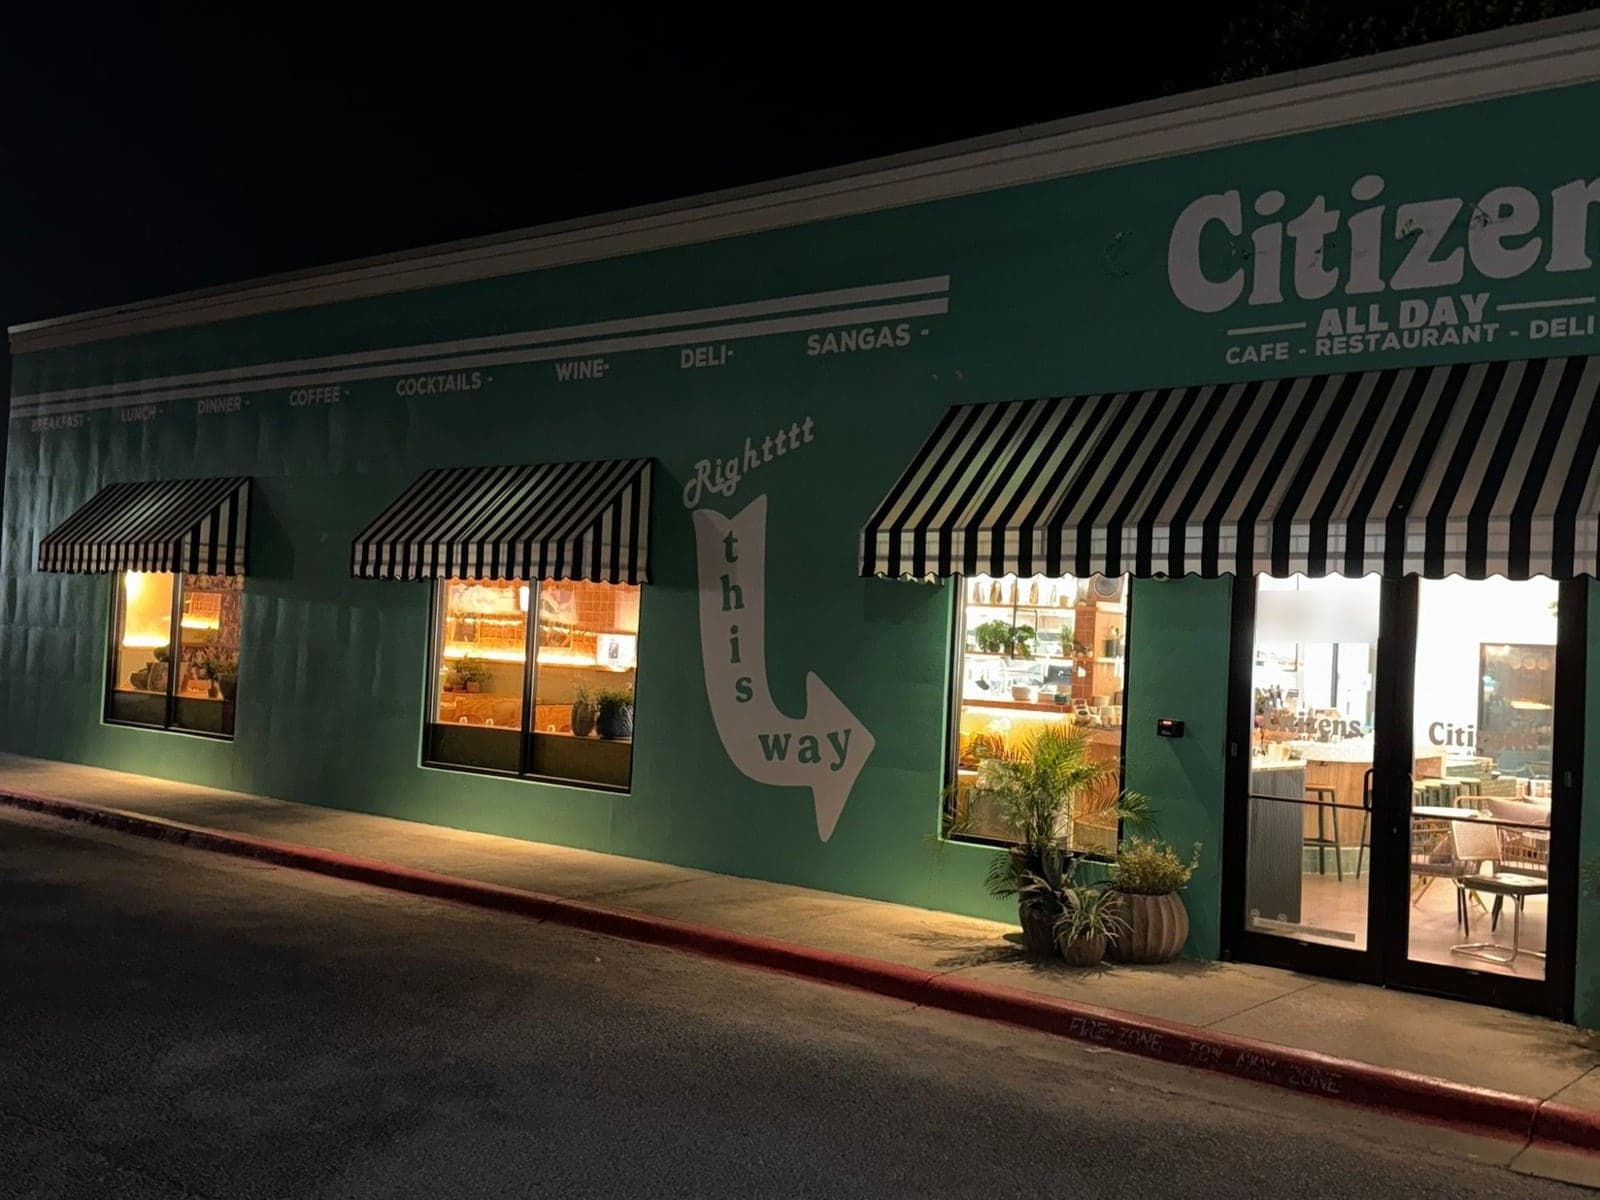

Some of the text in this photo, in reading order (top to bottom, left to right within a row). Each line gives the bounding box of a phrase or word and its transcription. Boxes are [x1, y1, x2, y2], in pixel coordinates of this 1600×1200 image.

[1225, 341, 1289, 366] CAFE
[1314, 322, 1499, 358] RESTAURANT
[1529, 315, 1595, 340] DELI
[1316, 292, 1491, 338] ALL DAY
[31, 413, 84, 432] BREAKFAST
[120, 406, 156, 423] LUNCH
[196, 395, 242, 416] DINNER
[288, 386, 341, 407] COFFEE
[395, 371, 482, 398] COCKTAILS
[806, 323, 911, 356] SANGAS
[682, 415, 816, 510] Rightttt
[721, 529, 755, 703] this
[758, 728, 853, 772] way
